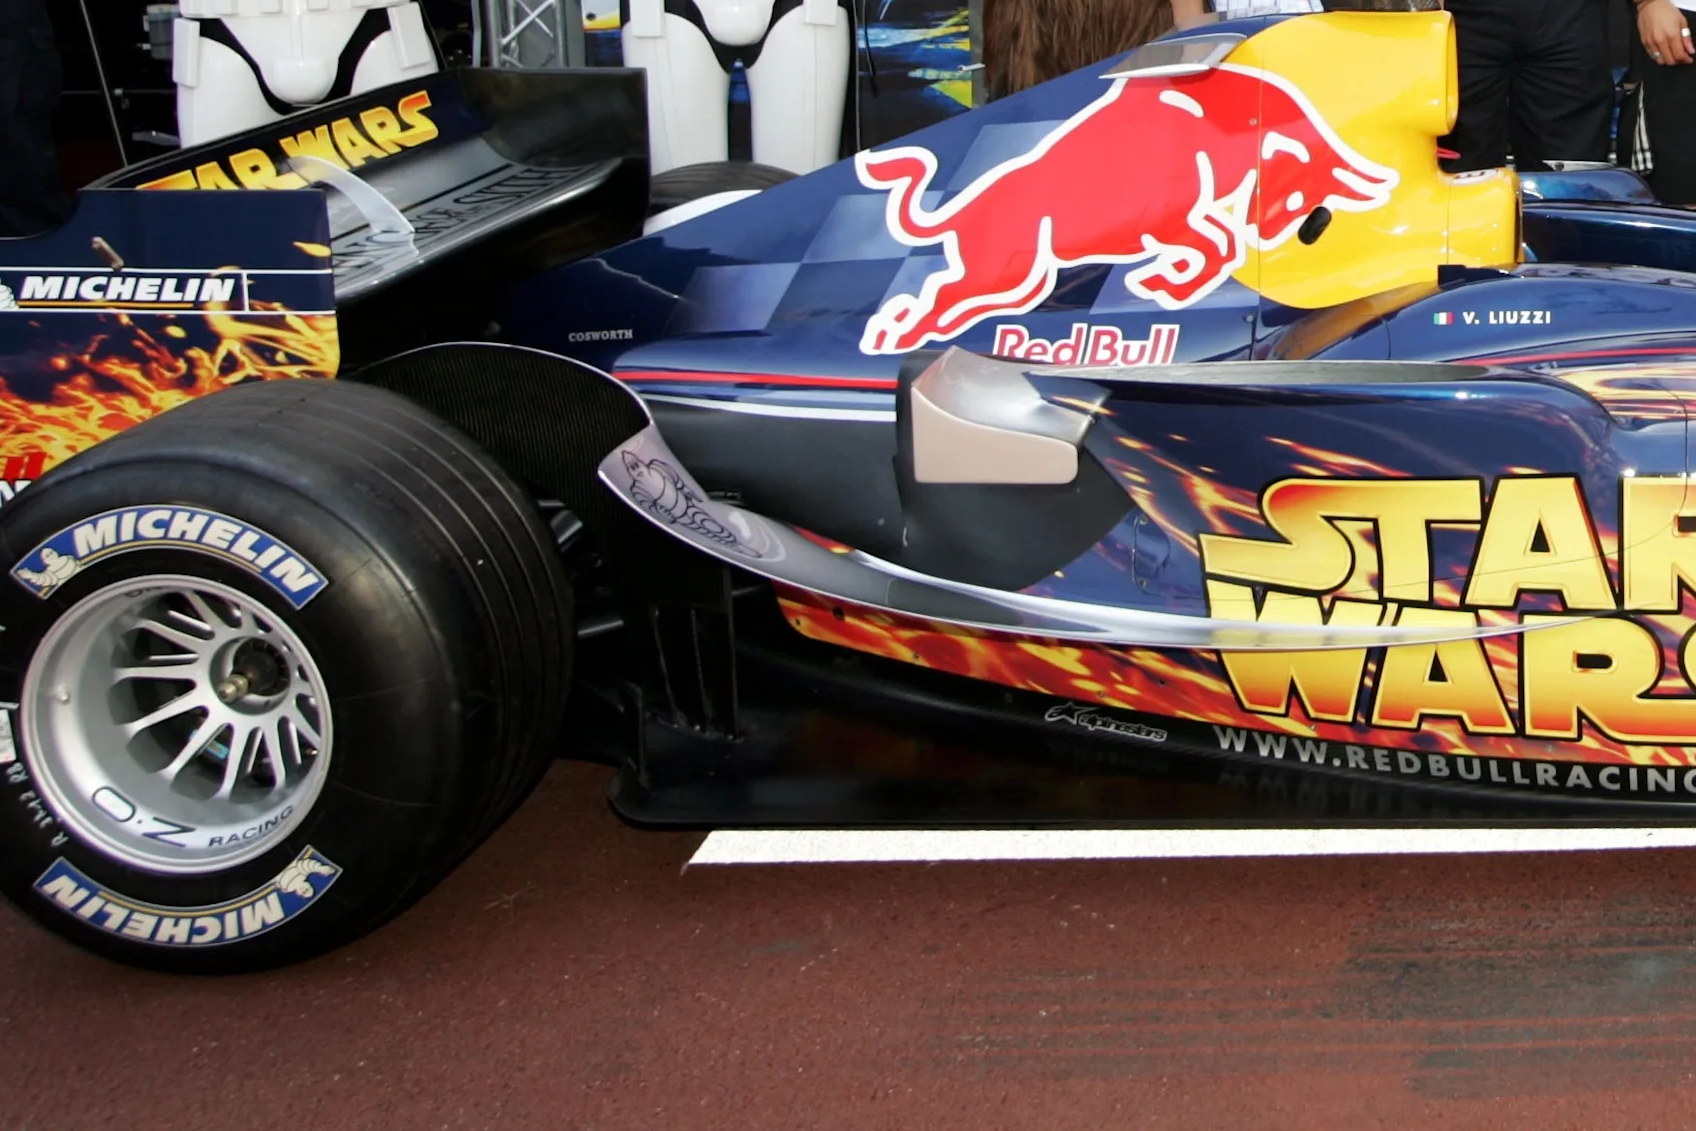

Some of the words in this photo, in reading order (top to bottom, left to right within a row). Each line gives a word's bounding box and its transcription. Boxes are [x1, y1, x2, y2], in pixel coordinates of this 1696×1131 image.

[278, 89, 439, 170] WARS
[20, 275, 236, 302] MICHELIN
[568, 329, 634, 342] COSWORTH
[1462, 311, 1480, 325] V.
[1489, 311, 1551, 325] LIUZZI
[994, 324, 1086, 366] Red
[1086, 325, 1179, 366] Bull
[73, 509, 320, 593] MICHELIN
[207, 805, 294, 848] RACING
[42, 874, 286, 944] MICHELIN
